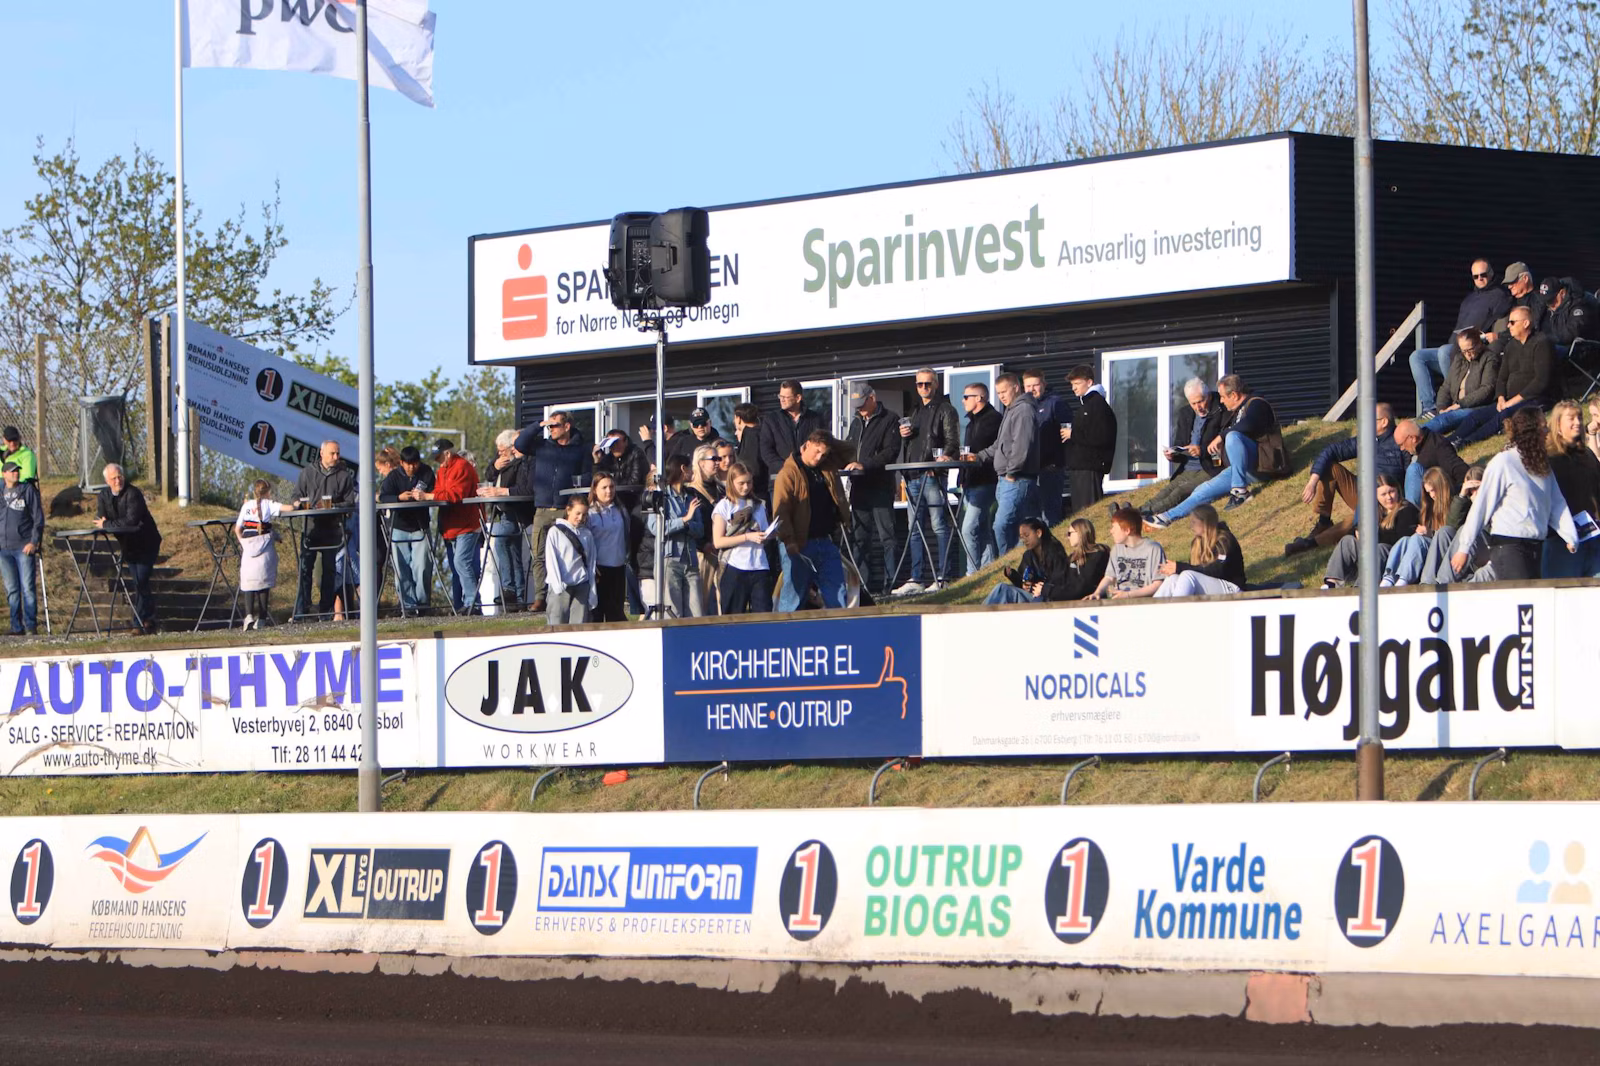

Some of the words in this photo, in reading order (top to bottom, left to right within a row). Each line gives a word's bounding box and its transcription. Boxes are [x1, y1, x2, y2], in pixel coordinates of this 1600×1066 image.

[802, 203, 1045, 309] Sparinvest
[1057, 233, 1147, 268] Ansvarlig
[1153, 220, 1263, 253] investering
[556, 315, 574, 335] for
[580, 310, 617, 333] Nørre
[689, 302, 739, 324] Omegn
[219, 356, 250, 376] HANSENS
[260, 369, 276, 400] 1
[289, 384, 321, 417] XL
[214, 409, 246, 430] HANSENS
[253, 423, 269, 454] 1
[691, 645, 829, 681] KIRCHHEINER
[835, 644, 860, 675] EL
[1521, 608, 1534, 706] MINK
[9, 647, 404, 716] AUTO-THYME
[480, 656, 593, 717] JAK
[1025, 671, 1146, 701] NORDICALS
[8, 725, 41, 744] SALG
[51, 723, 103, 743] SERVICE
[115, 721, 195, 742] REPARATION
[233, 715, 305, 737] Vesterbyvej
[309, 714, 320, 735] 2,
[324, 713, 353, 732] 6840
[1050, 709, 1121, 724] erhvervsmæglere
[42, 748, 158, 768] www.auto-thyme.dk
[271, 745, 291, 764] Tlf:
[295, 745, 310, 763] 28
[314, 745, 327, 763] 11
[331, 744, 347, 762] 44
[483, 742, 597, 759] WORKWEAR
[16, 841, 42, 916] 1
[248, 841, 276, 920] 1
[547, 864, 621, 898] DANSK
[865, 843, 1023, 888] OUTRUP
[1172, 841, 1266, 893] Varde
[305, 853, 365, 914] XL
[357, 854, 369, 892] BYG
[373, 868, 444, 902] OUTRUP
[474, 843, 503, 926] 1
[788, 843, 821, 931] 1
[1055, 841, 1092, 934] 1
[1346, 839, 1385, 937] 1
[91, 899, 139, 918] KØBMAND
[141, 900, 187, 918] HANSENS
[535, 916, 603, 933] ERHVERVS
[609, 917, 617, 933] &
[623, 917, 752, 935] PROFILEKSPERTEN
[863, 893, 1012, 938] BIOGAS
[1134, 888, 1302, 941] Kommune
[88, 922, 183, 940] FERIEHUSUDLEJNING
